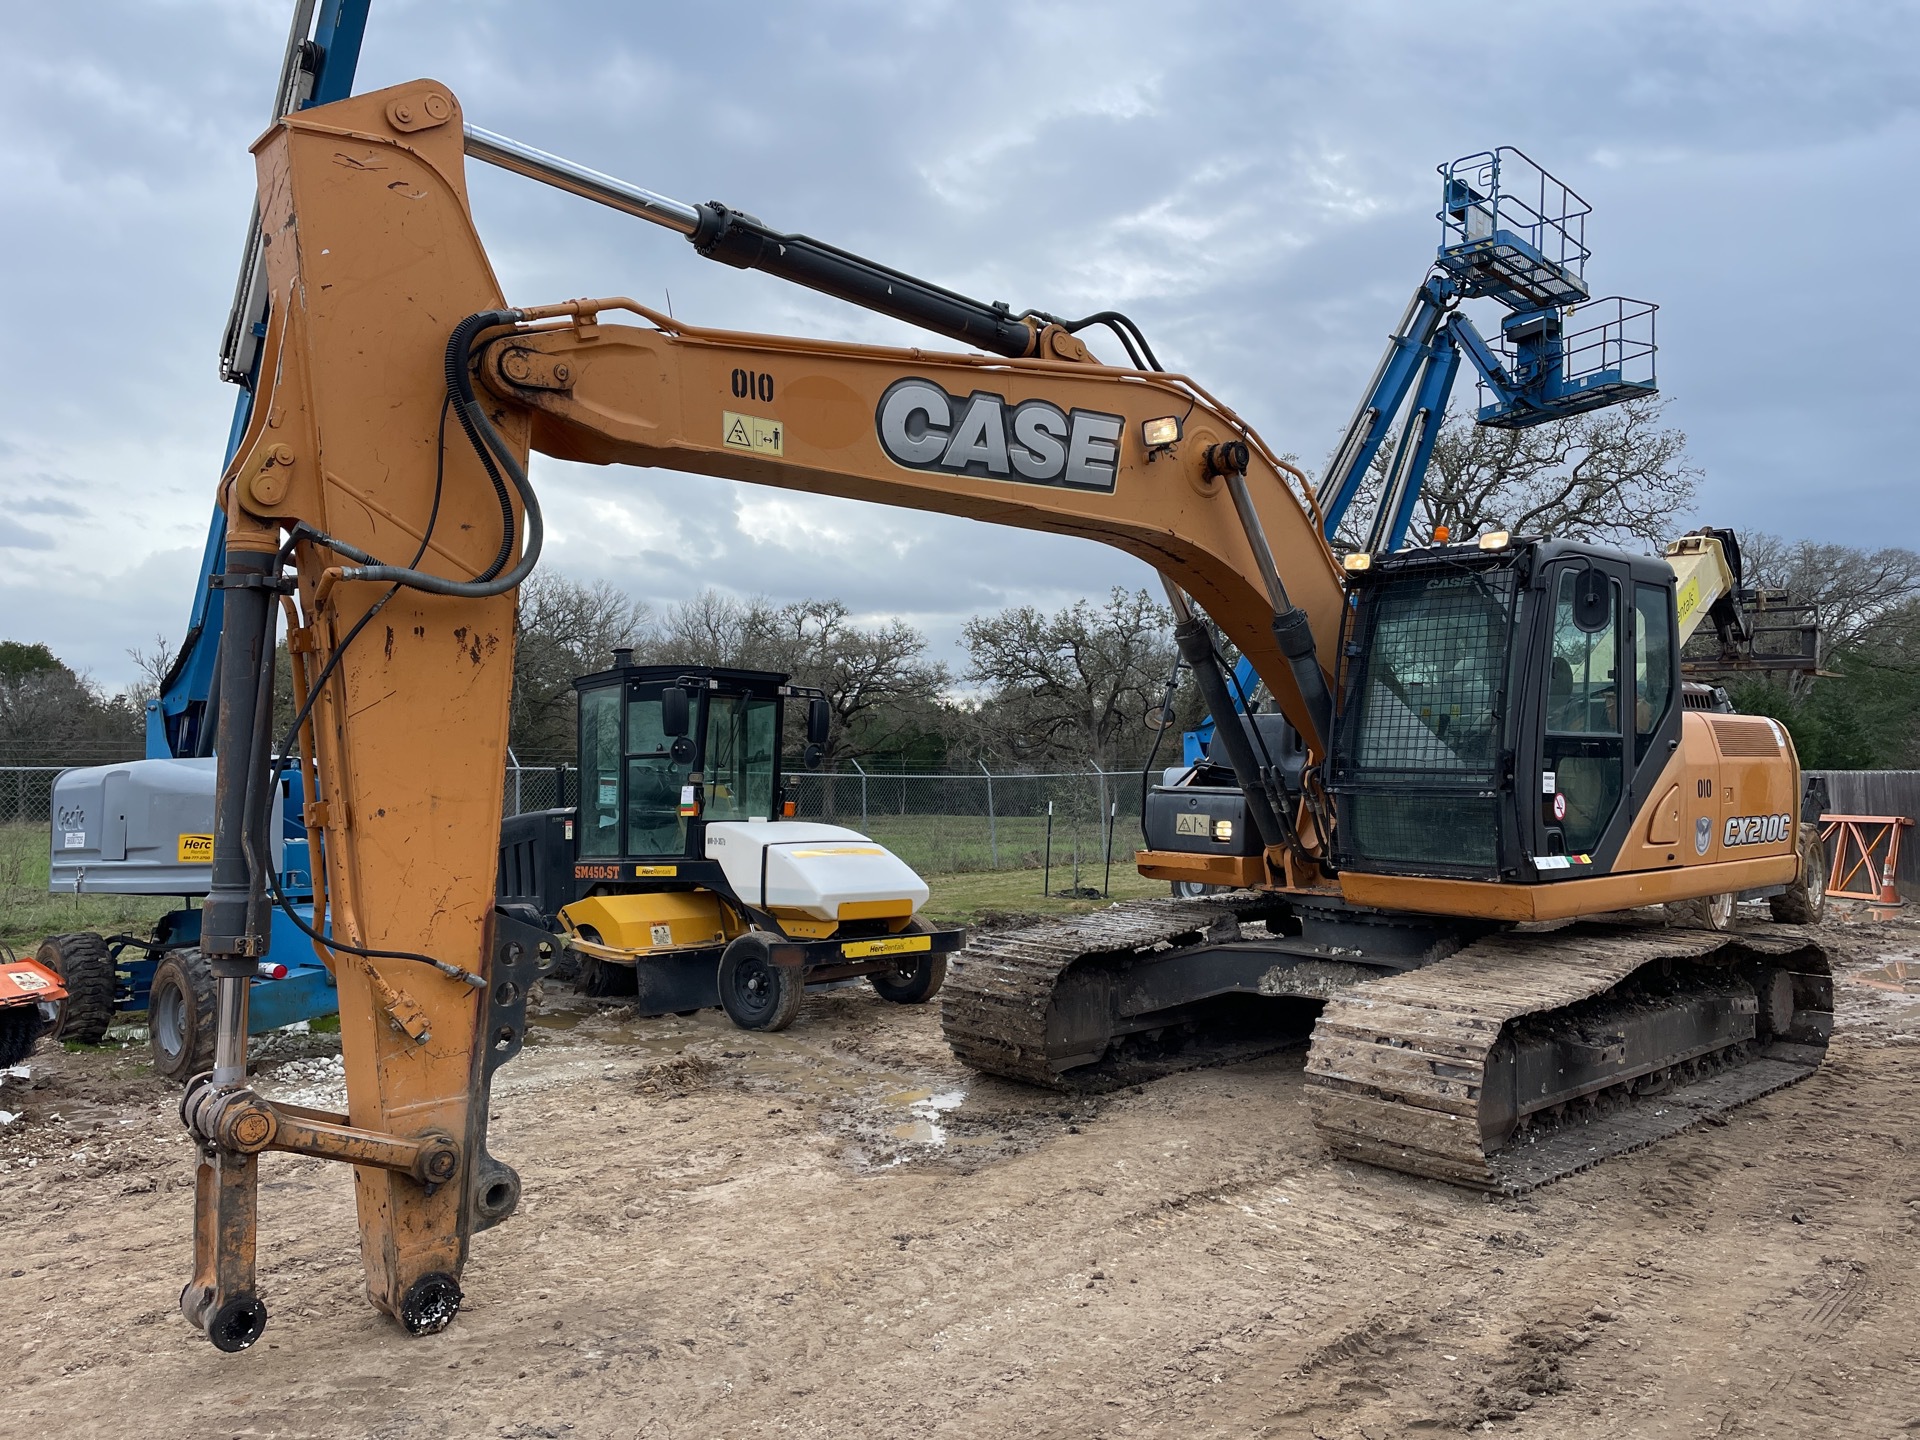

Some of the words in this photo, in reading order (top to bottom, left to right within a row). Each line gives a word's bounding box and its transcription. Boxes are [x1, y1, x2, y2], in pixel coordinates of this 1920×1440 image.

[731, 368, 774, 402] 010
[878, 380, 1124, 490] CASE
[1677, 591, 1694, 624] entals
[1697, 779, 1712, 798] 010
[184, 839, 211, 849] Herc
[1723, 813, 1791, 847] CX210C
[574, 866, 620, 879] SM450-ST
